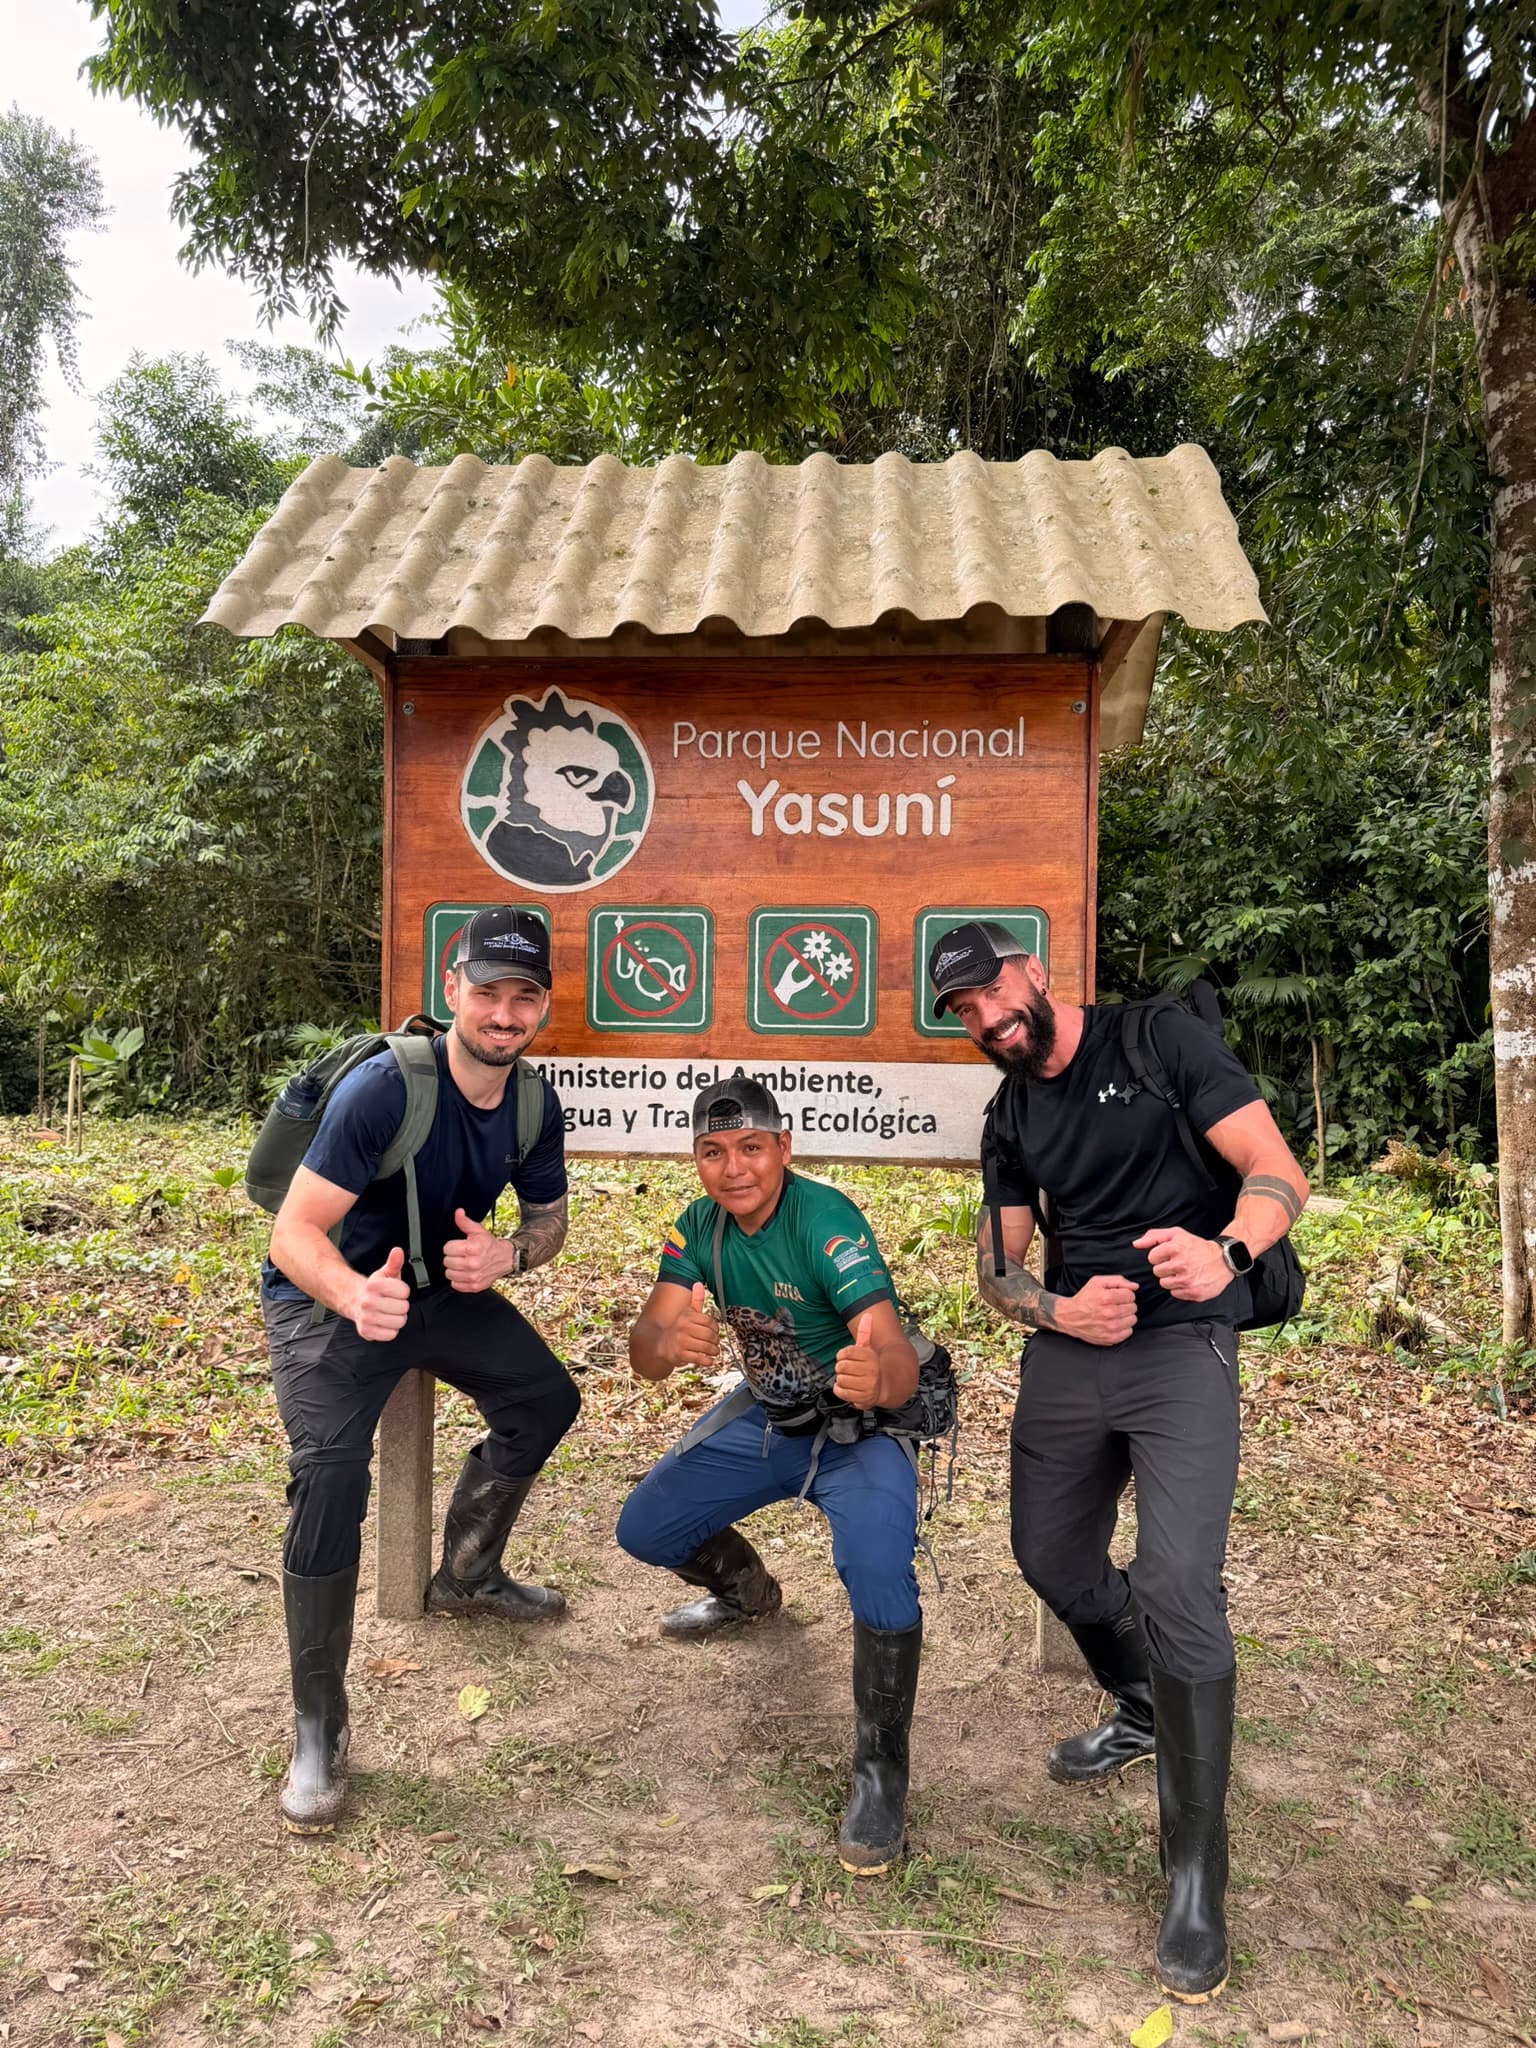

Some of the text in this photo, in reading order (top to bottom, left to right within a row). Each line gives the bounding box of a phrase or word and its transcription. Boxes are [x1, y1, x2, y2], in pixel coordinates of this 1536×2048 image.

[673, 716, 1025, 769] Parque Nacional
[736, 774, 957, 837] Yasuní
[676, 1064, 719, 1090] del
[563, 1107, 611, 1132] gua
[622, 1109, 637, 1133] y
[802, 1106, 937, 1139] Ecológica
